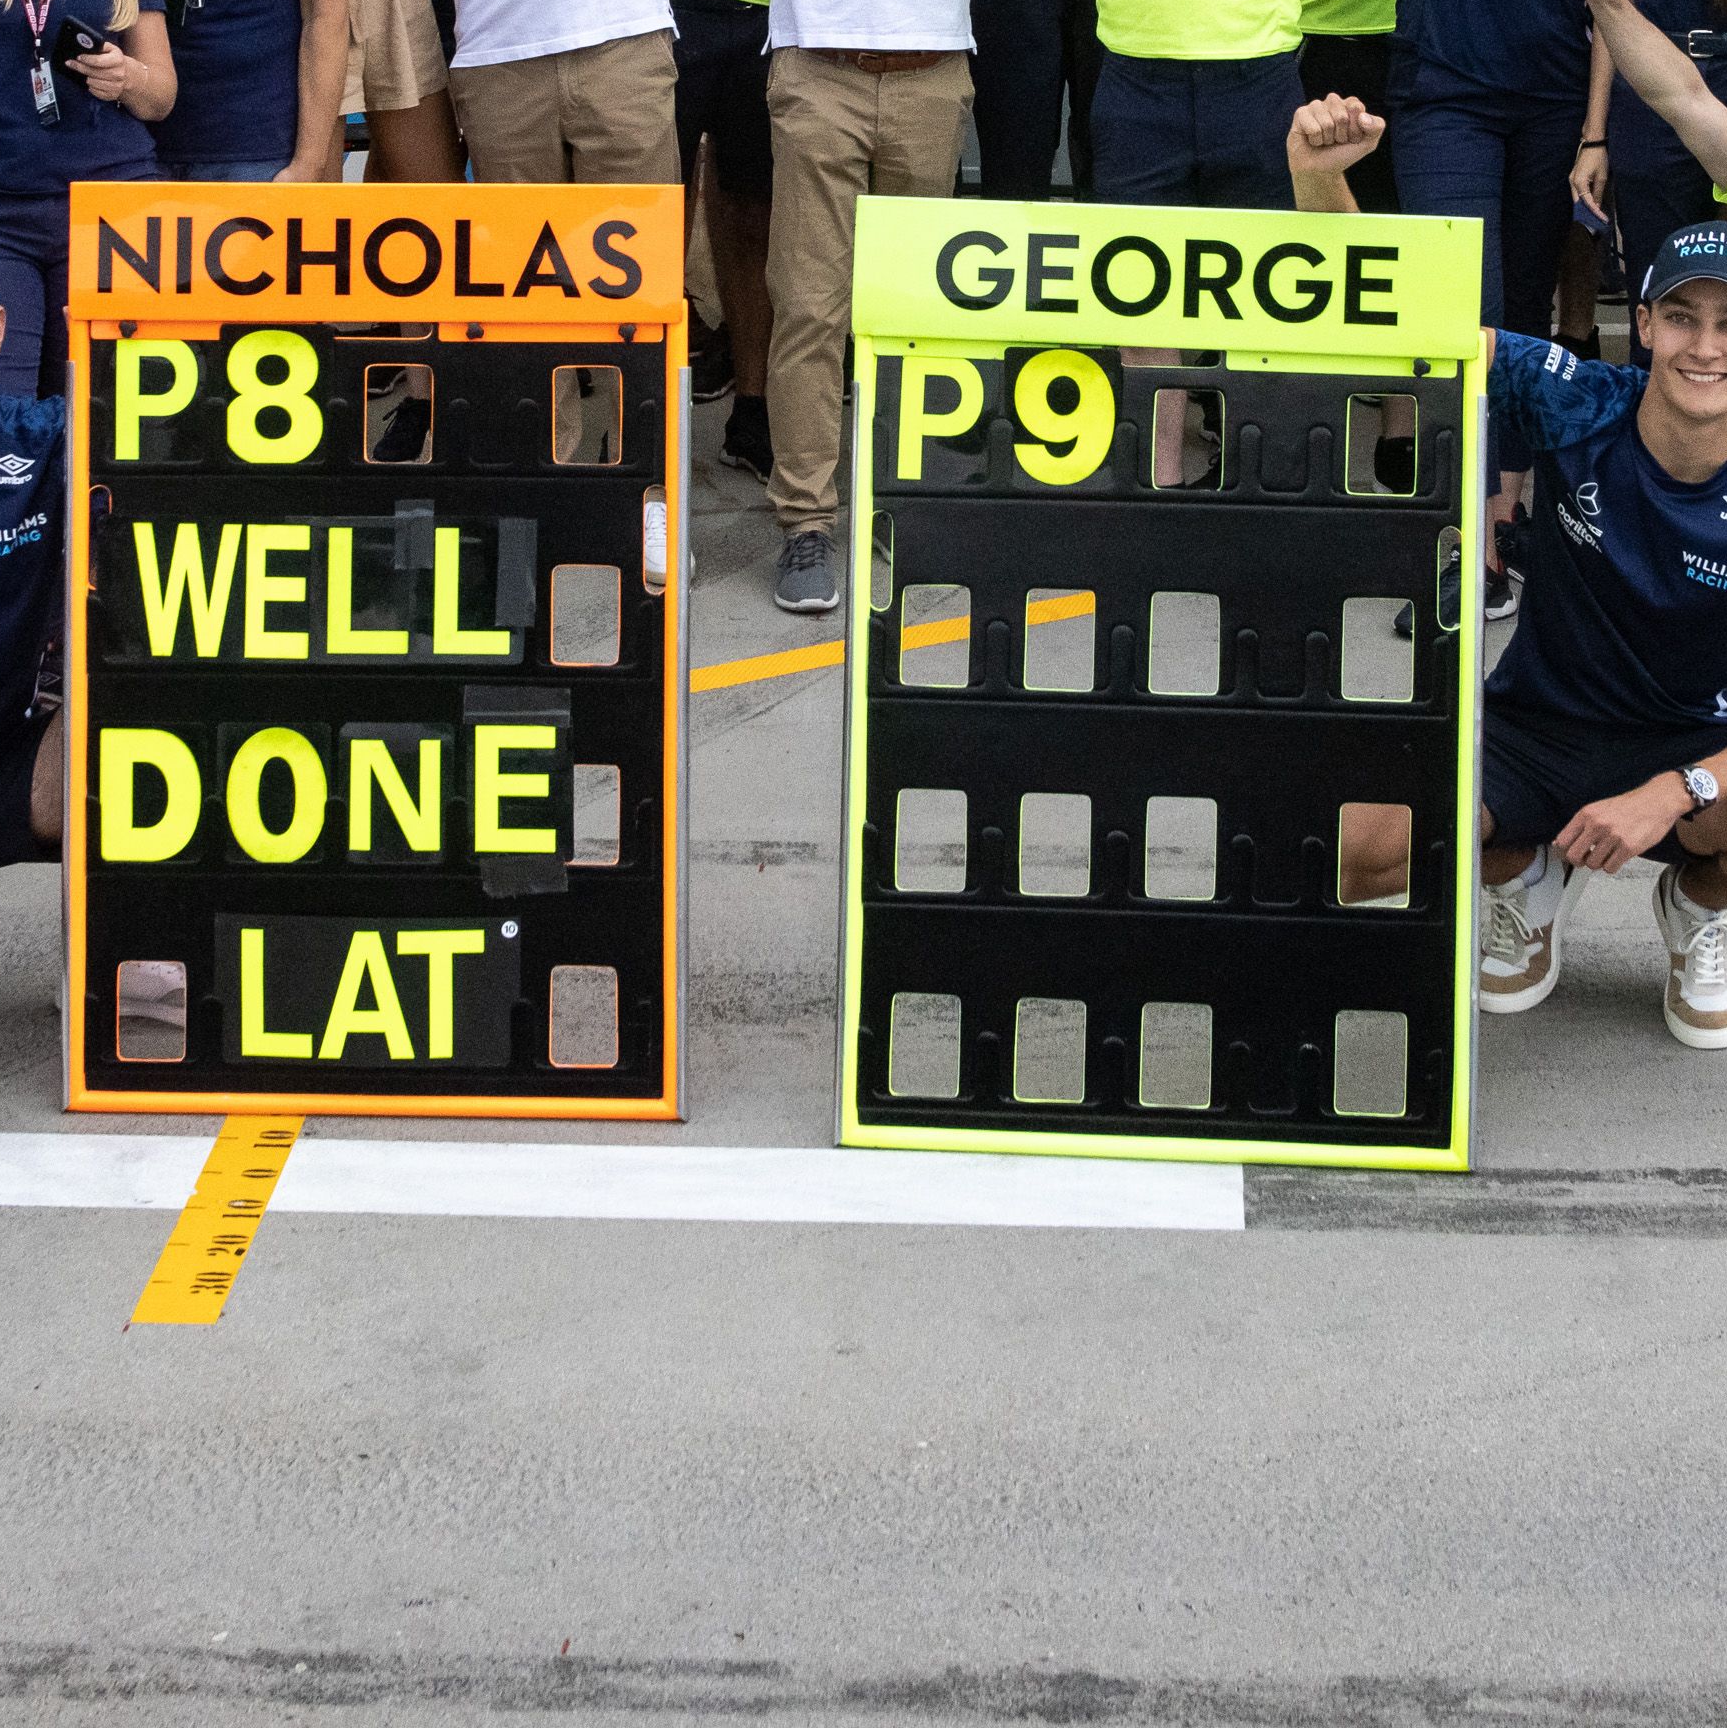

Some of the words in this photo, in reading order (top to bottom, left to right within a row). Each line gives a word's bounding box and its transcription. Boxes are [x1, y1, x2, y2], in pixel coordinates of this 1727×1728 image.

[96, 216, 643, 300] NICHOLAS
[935, 230, 1399, 326] GEORGE
[114, 330, 324, 464] P8
[897, 349, 1116, 486] P9
[132, 522, 512, 660] WELL
[99, 724, 558, 863] DONE
[239, 927, 486, 1060] LAT
